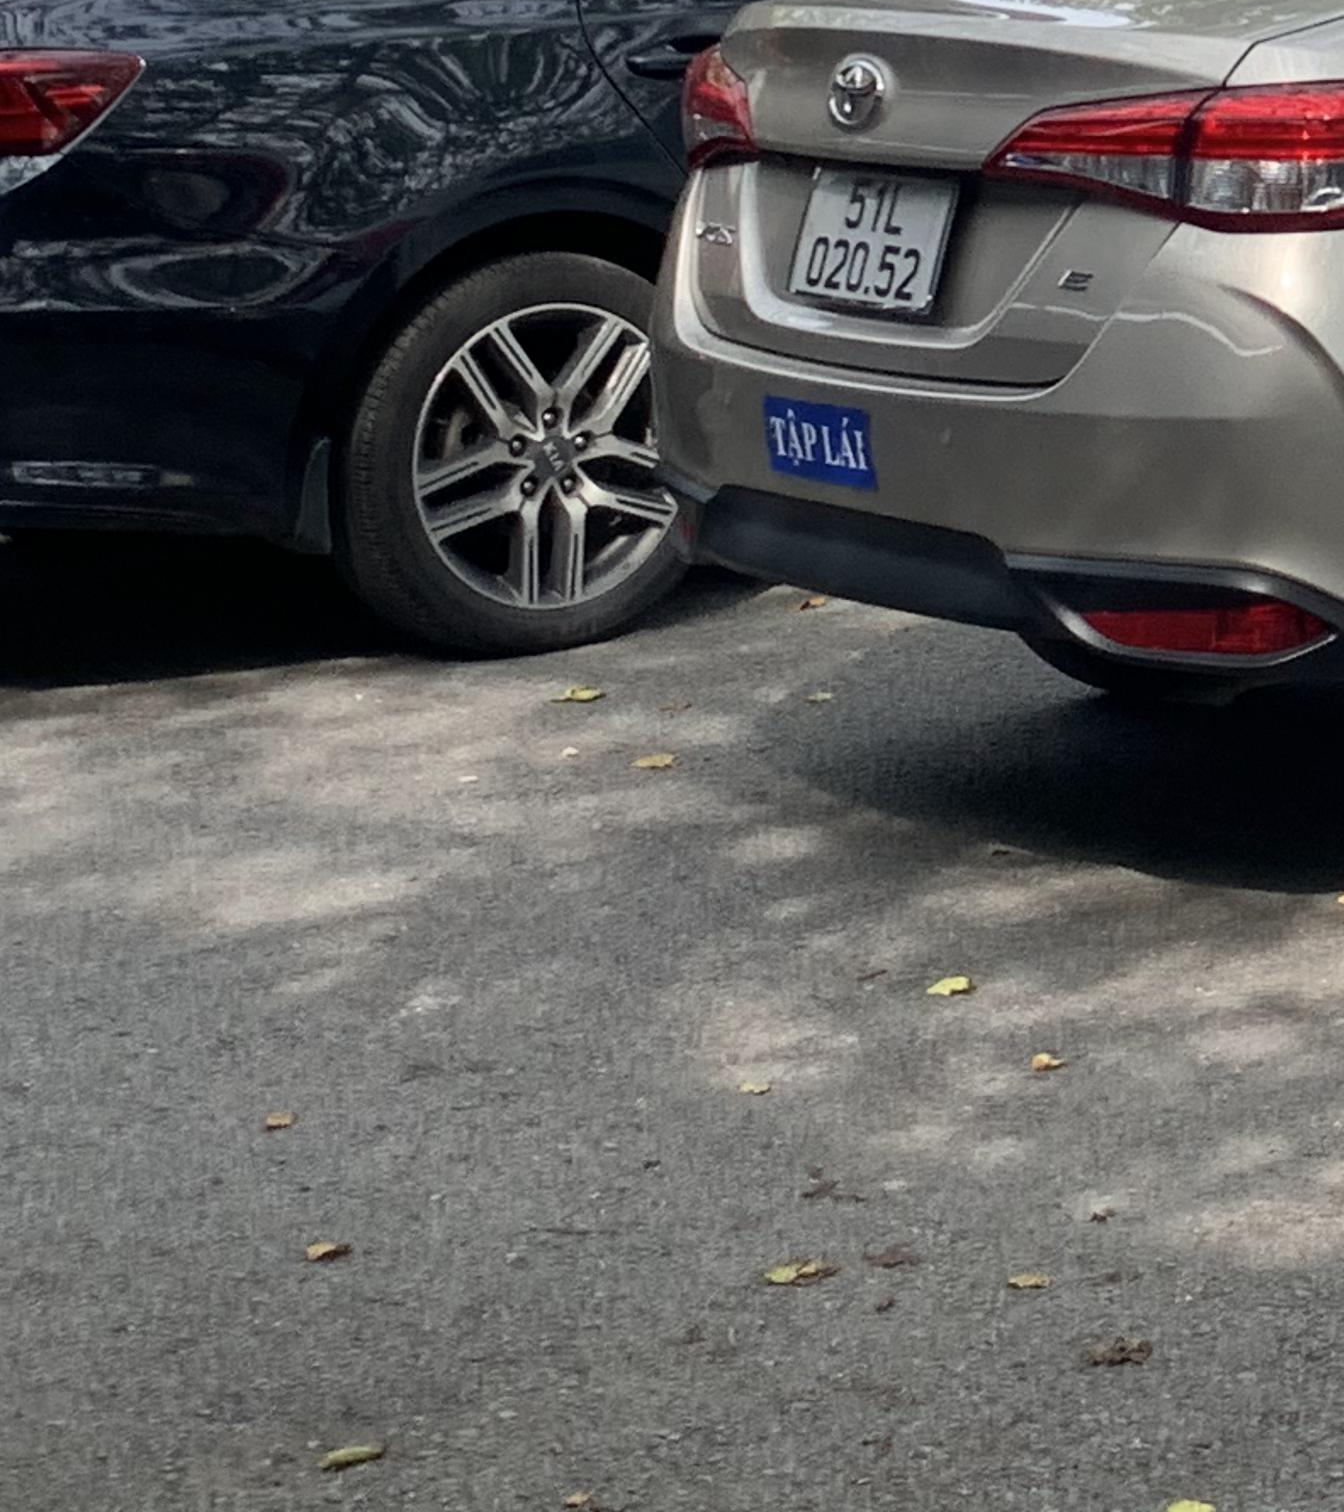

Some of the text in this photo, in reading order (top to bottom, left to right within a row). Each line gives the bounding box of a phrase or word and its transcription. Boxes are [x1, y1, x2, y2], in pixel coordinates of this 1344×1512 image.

[845, 181, 902, 235] 51L
[806, 236, 921, 301] 020.52
[769, 408, 869, 471] TẬP LÁI
